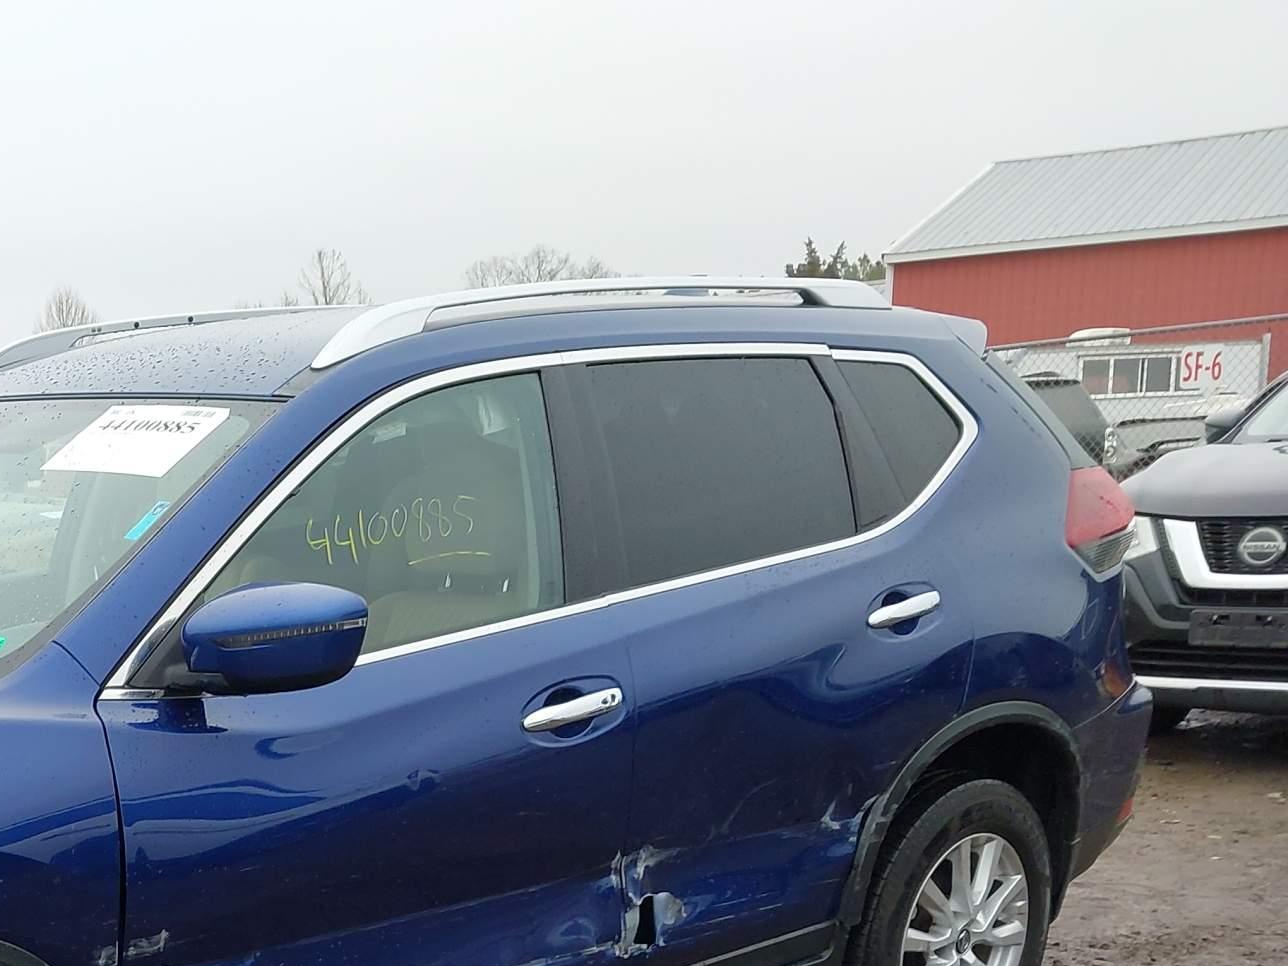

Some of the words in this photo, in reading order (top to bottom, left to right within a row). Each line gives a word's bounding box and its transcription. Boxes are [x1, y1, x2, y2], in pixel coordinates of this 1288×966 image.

[1182, 351, 1222, 382] SF-6
[99, 419, 201, 434] 44100885
[306, 495, 475, 565] 44100885
